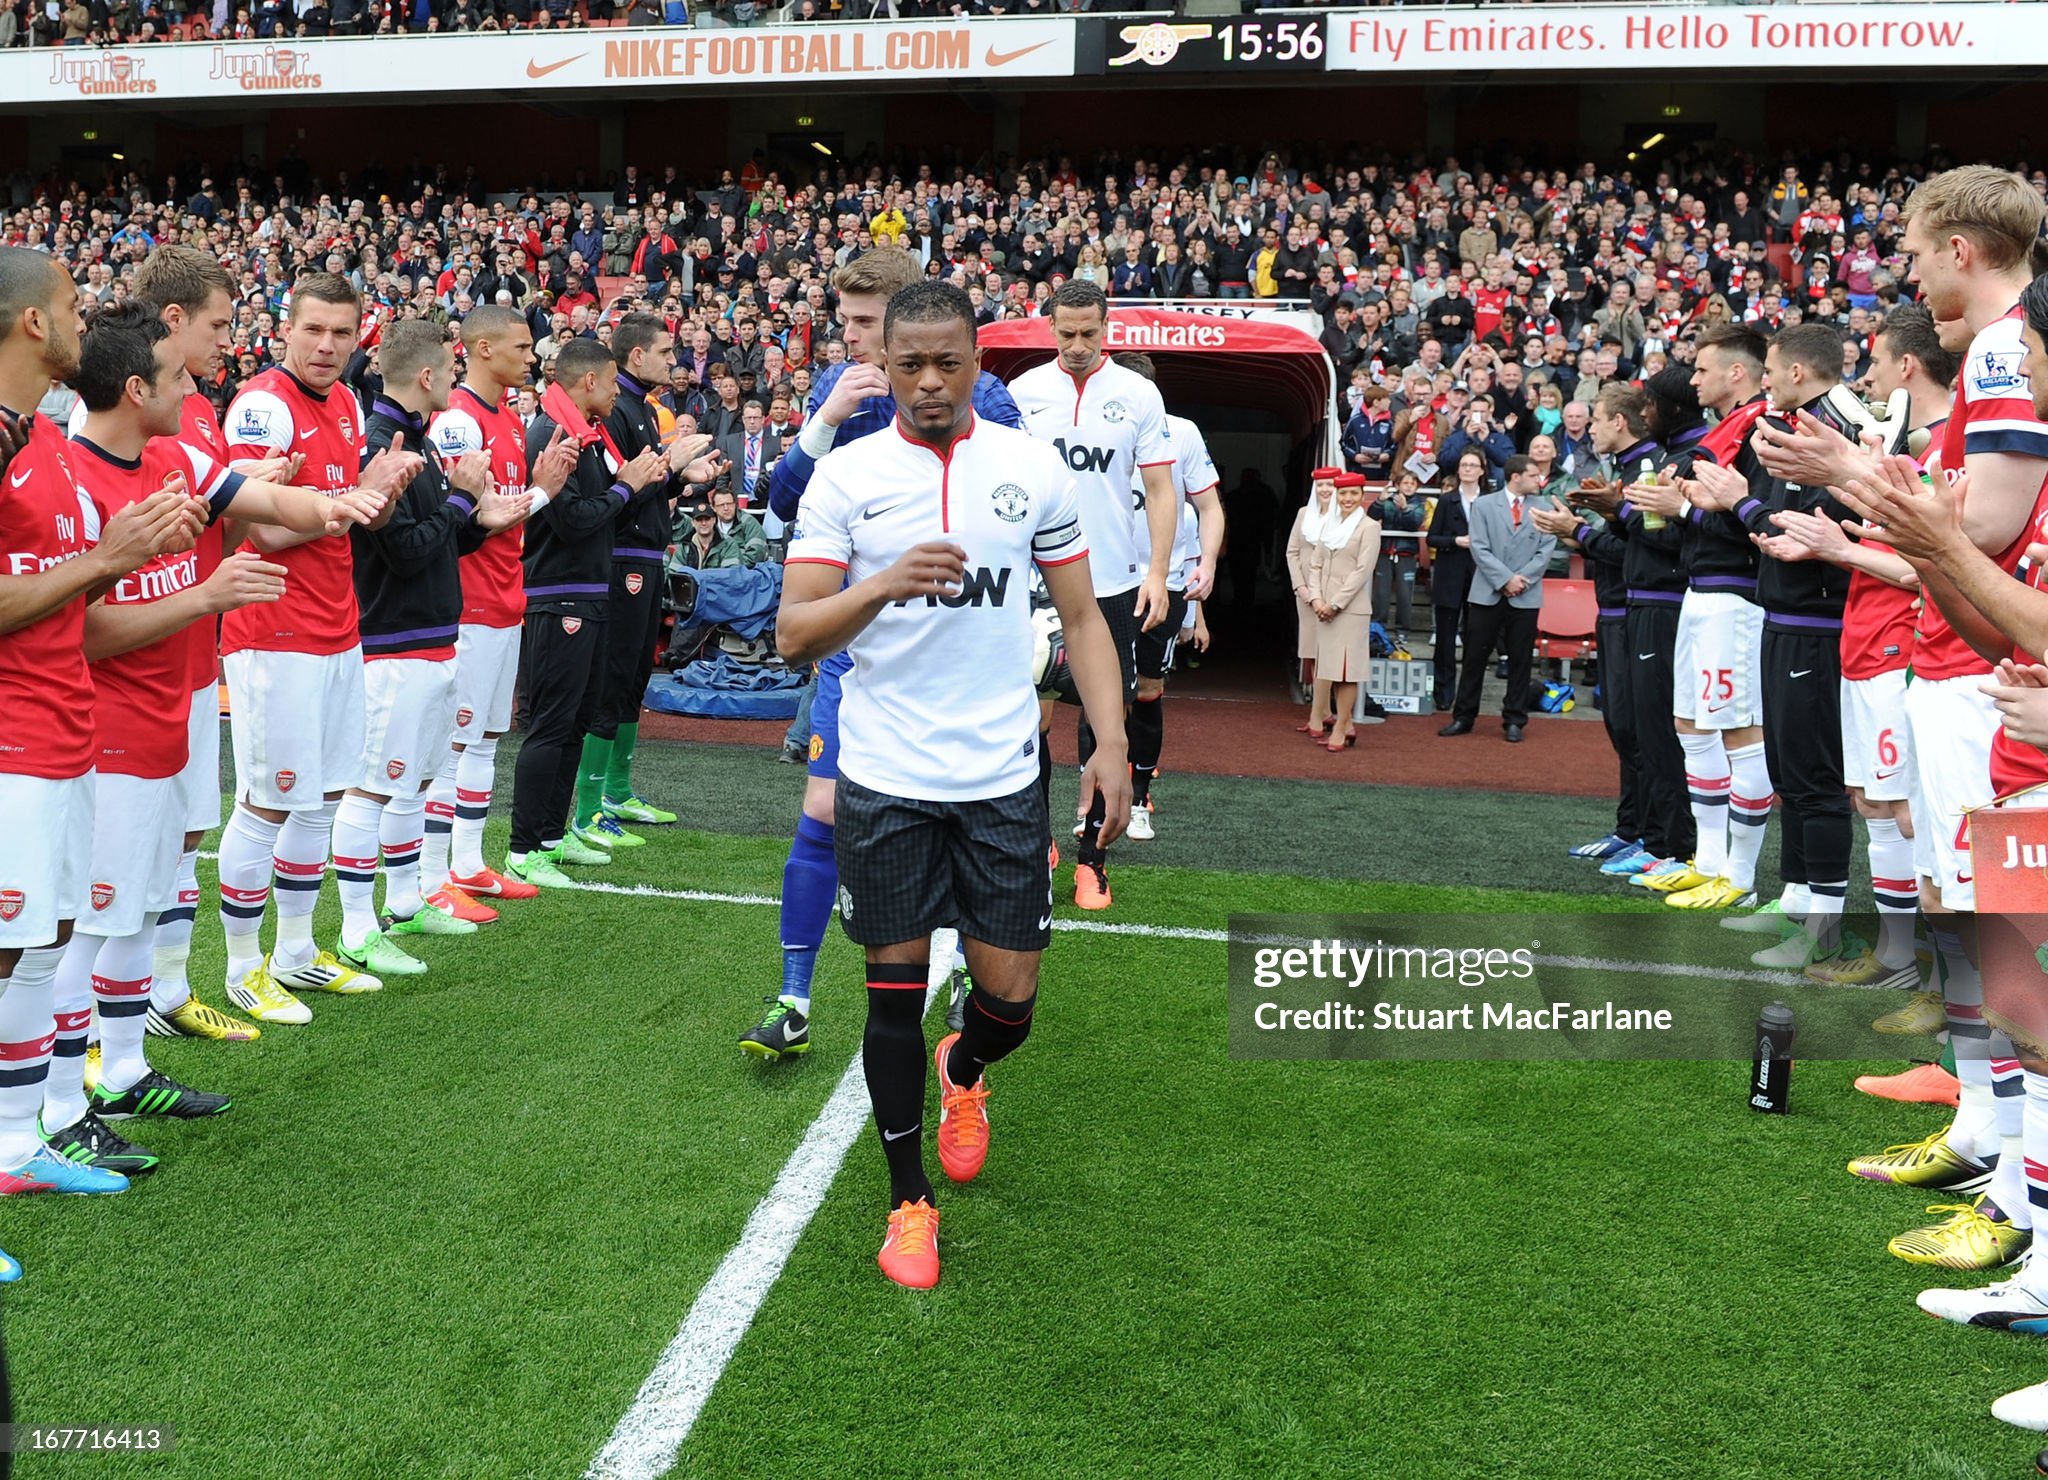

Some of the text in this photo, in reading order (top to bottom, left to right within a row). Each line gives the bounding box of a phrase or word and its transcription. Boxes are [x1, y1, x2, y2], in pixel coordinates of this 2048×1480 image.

[1217, 22, 1323, 61] 15:56
[1349, 14, 1975, 62] Fly Emirates. Hello Tomorrow.
[604, 30, 970, 78] NIKEFOOTBALL.COM
[78, 75, 157, 95] Gunners
[239, 70, 322, 91] Gunners
[1107, 319, 1225, 347] Emirates
[326, 464, 344, 484] Fly
[55, 513, 75, 544] Fly
[1702, 669, 1733, 700] 25
[1878, 728, 1898, 767] 6
[1757, 1042, 1771, 1090] Lucozade
